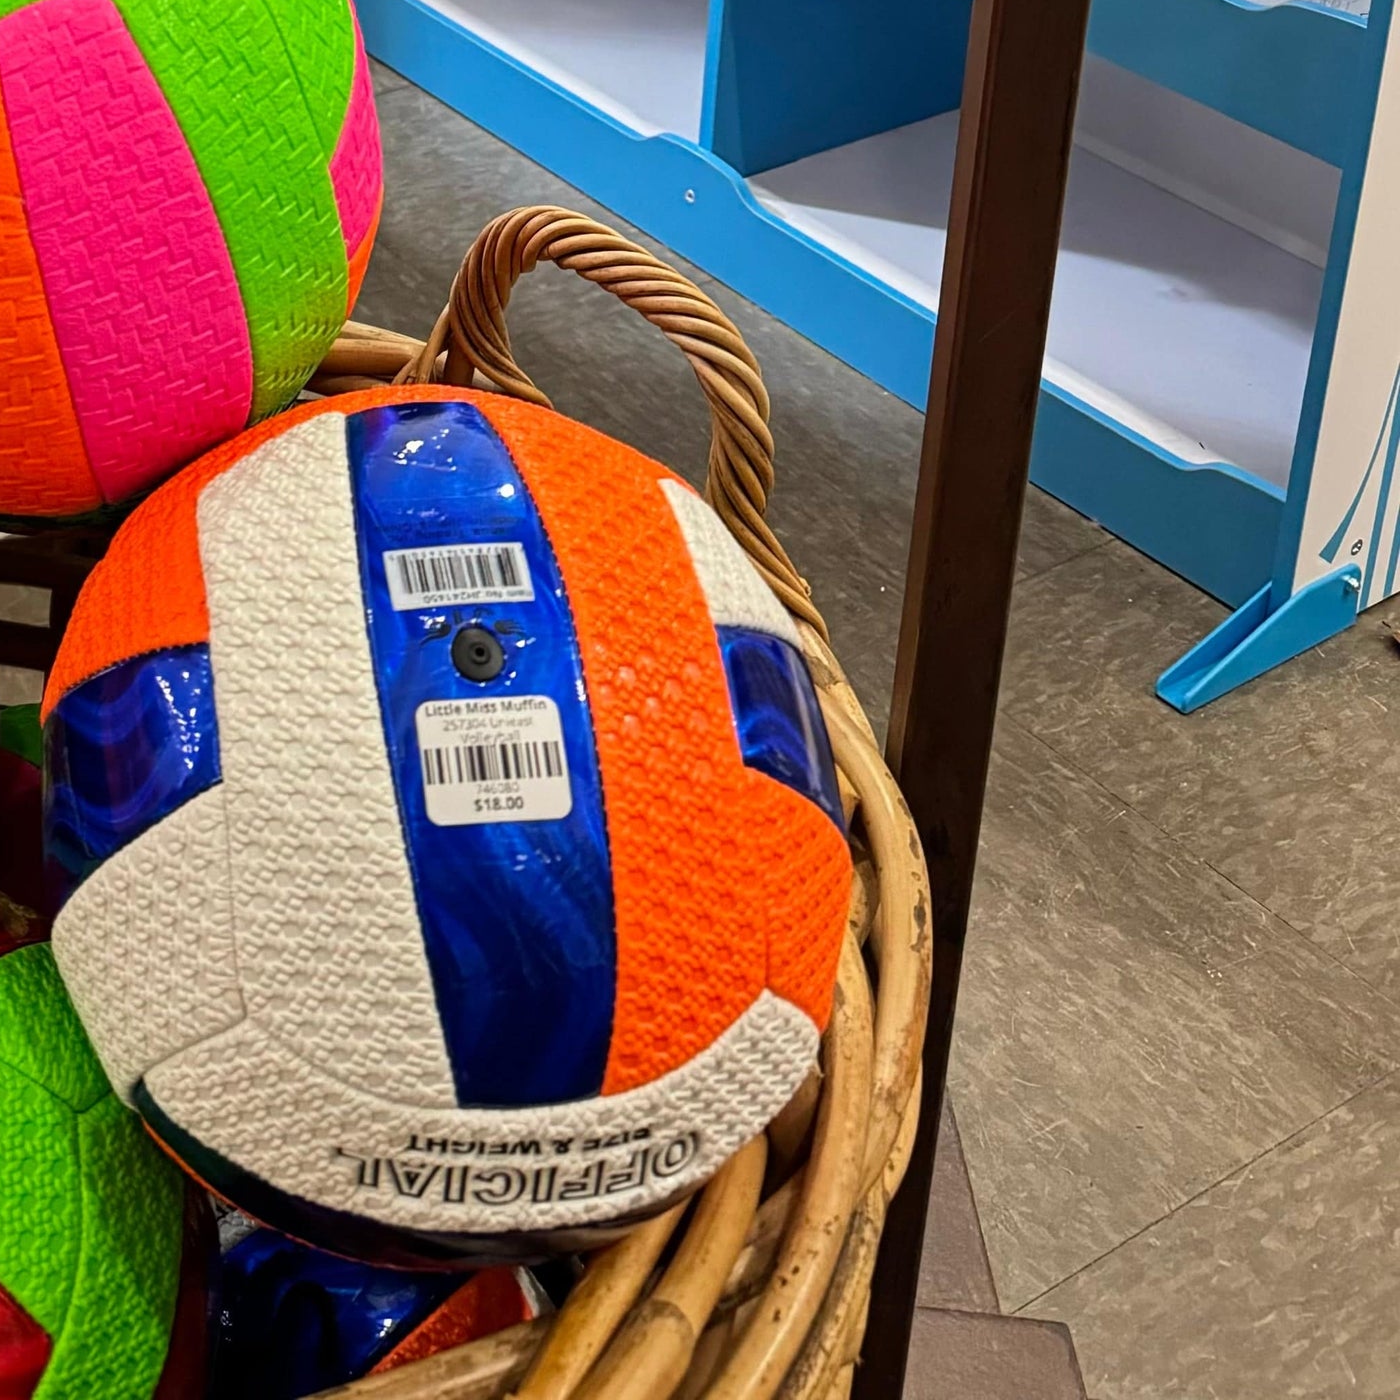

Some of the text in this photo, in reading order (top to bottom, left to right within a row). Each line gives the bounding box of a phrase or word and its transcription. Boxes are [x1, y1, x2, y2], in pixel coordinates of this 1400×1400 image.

[425, 699, 547, 717] Little Miss Muffin
[474, 796, 524, 812] $18.00
[407, 1133, 541, 1156] WEIGHT
[336, 1130, 700, 1206] OFFICIAL
